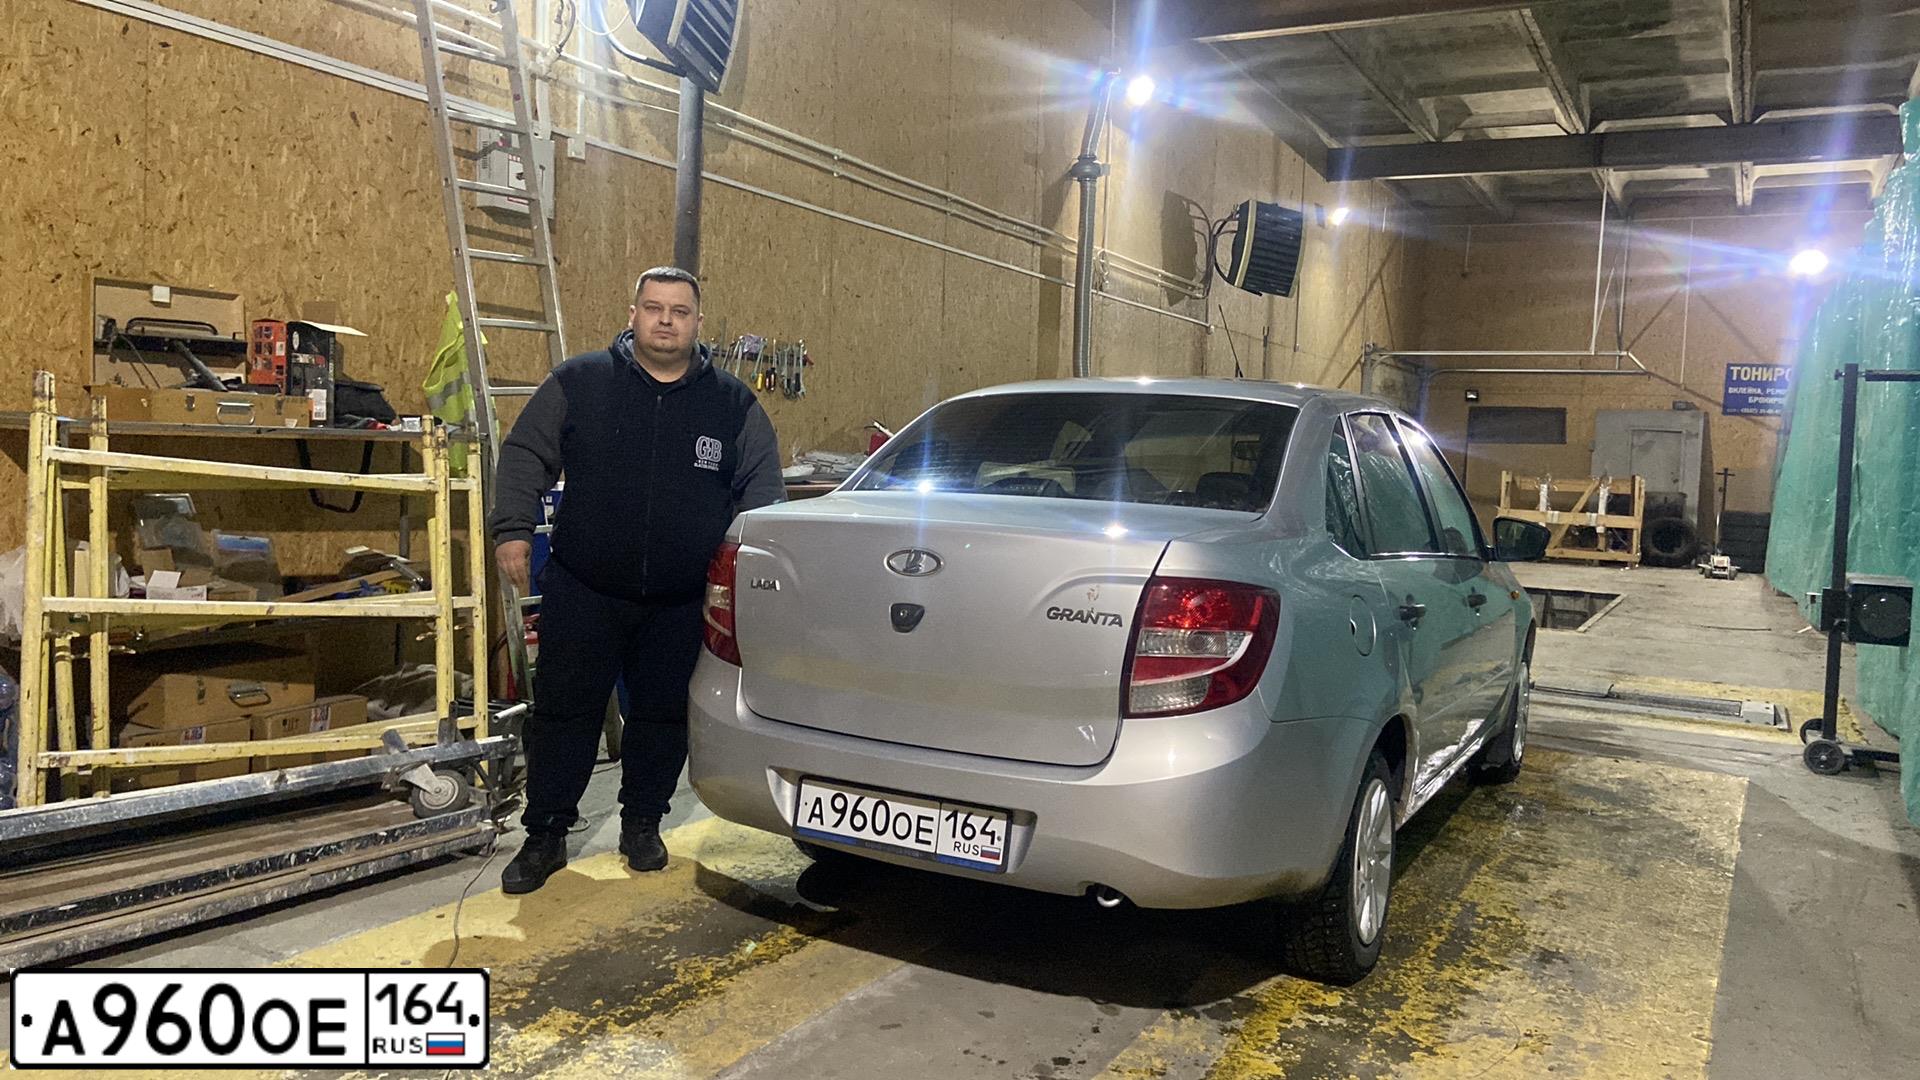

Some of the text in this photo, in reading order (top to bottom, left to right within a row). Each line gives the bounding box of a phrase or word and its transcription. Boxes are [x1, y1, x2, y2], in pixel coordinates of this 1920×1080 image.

[751, 577, 781, 591] LADA
[1046, 606, 1123, 627] GRANTA
[807, 792, 997, 846] А960ОЕ 164
[953, 840, 980, 856] RUS
